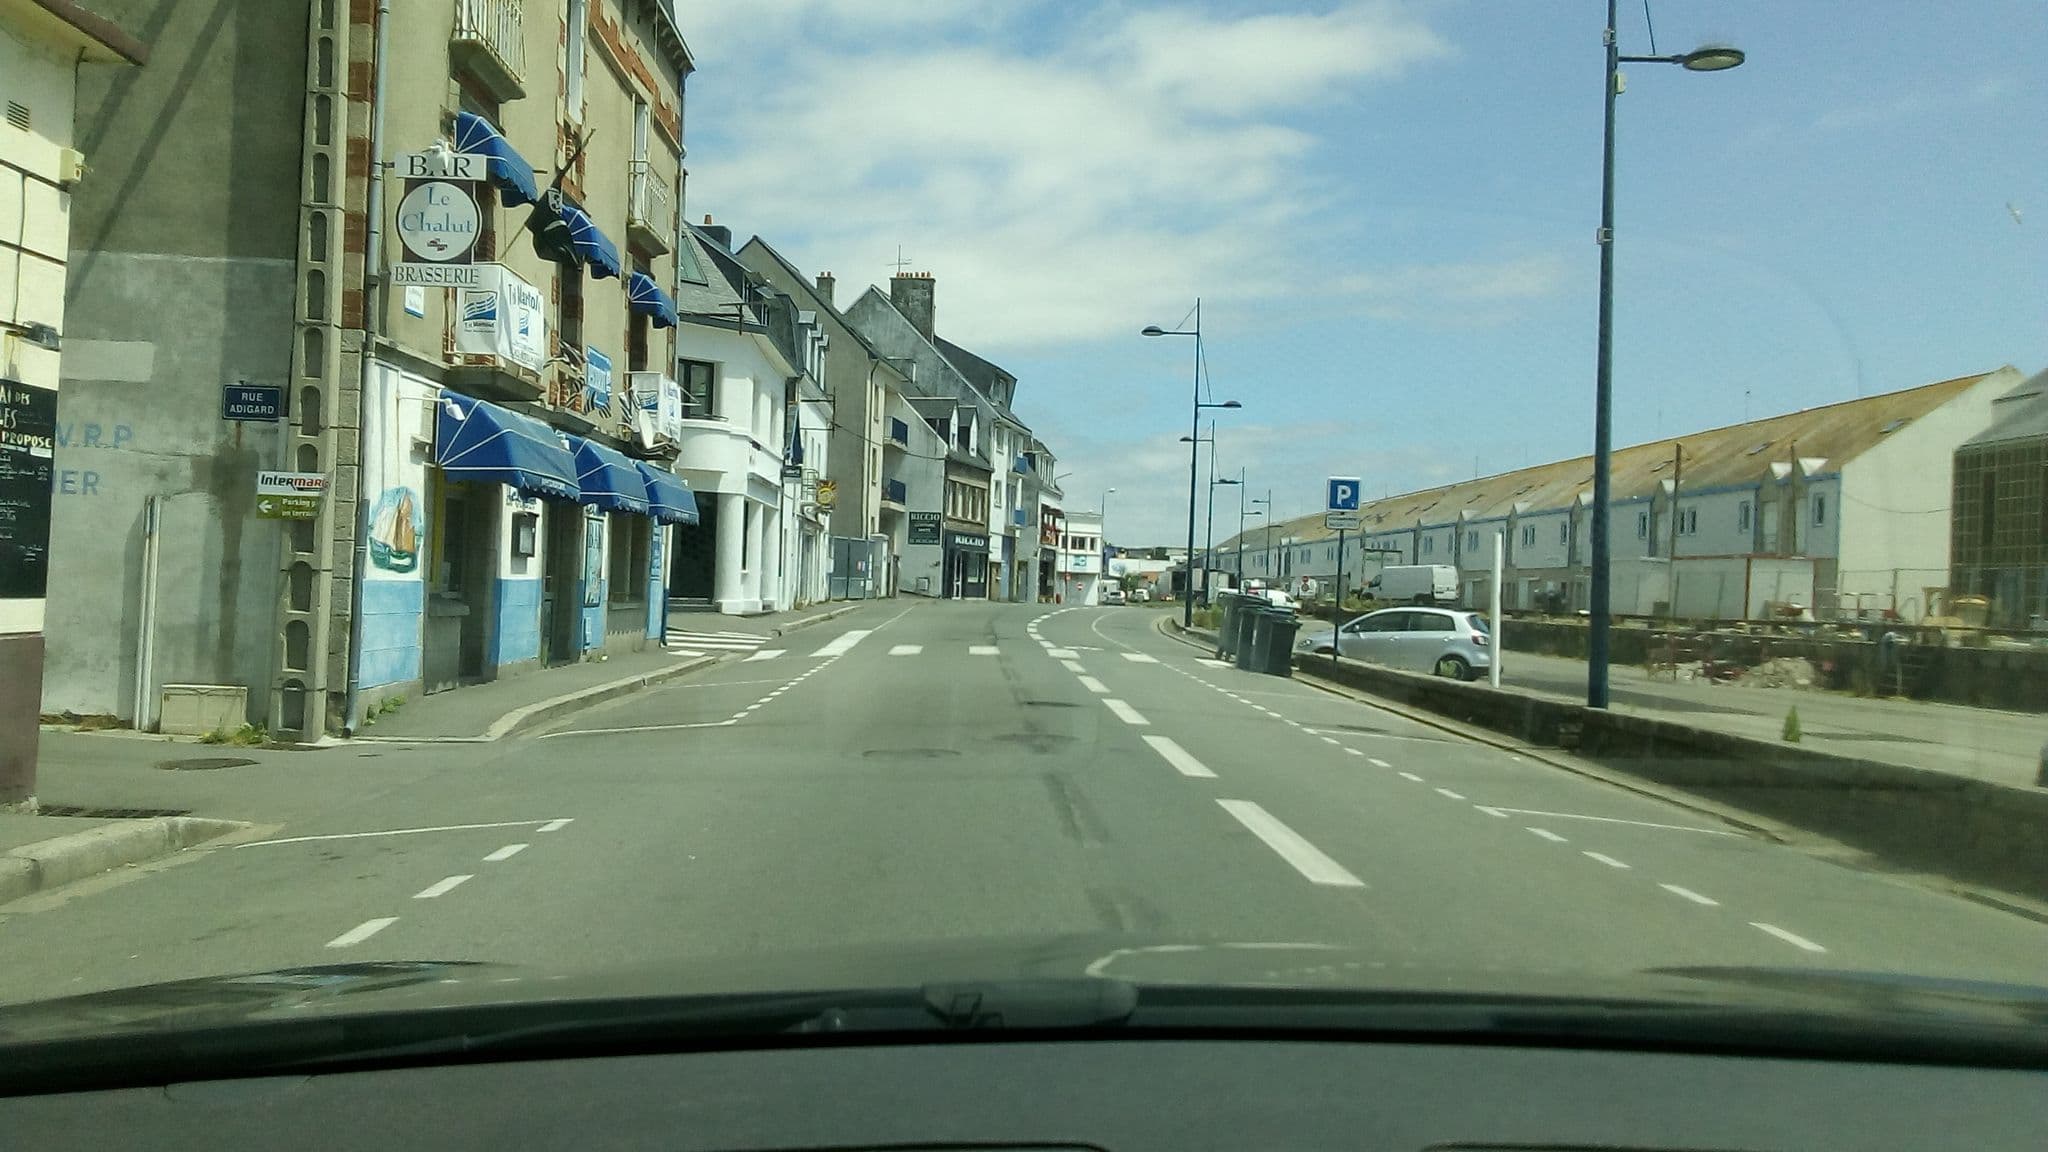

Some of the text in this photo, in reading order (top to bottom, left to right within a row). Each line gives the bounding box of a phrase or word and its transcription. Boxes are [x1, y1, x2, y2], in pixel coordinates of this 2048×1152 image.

[427, 186, 450, 206] Le
[402, 212, 473, 233] Chalut
[394, 266, 480, 284] BRASSERIE
[241, 392, 264, 402] RUE
[229, 404, 275, 415] ADIGARD
[1337, 484, 1351, 505] P
[911, 513, 940, 521] RICCIO
[955, 535, 984, 547] RICCIO
